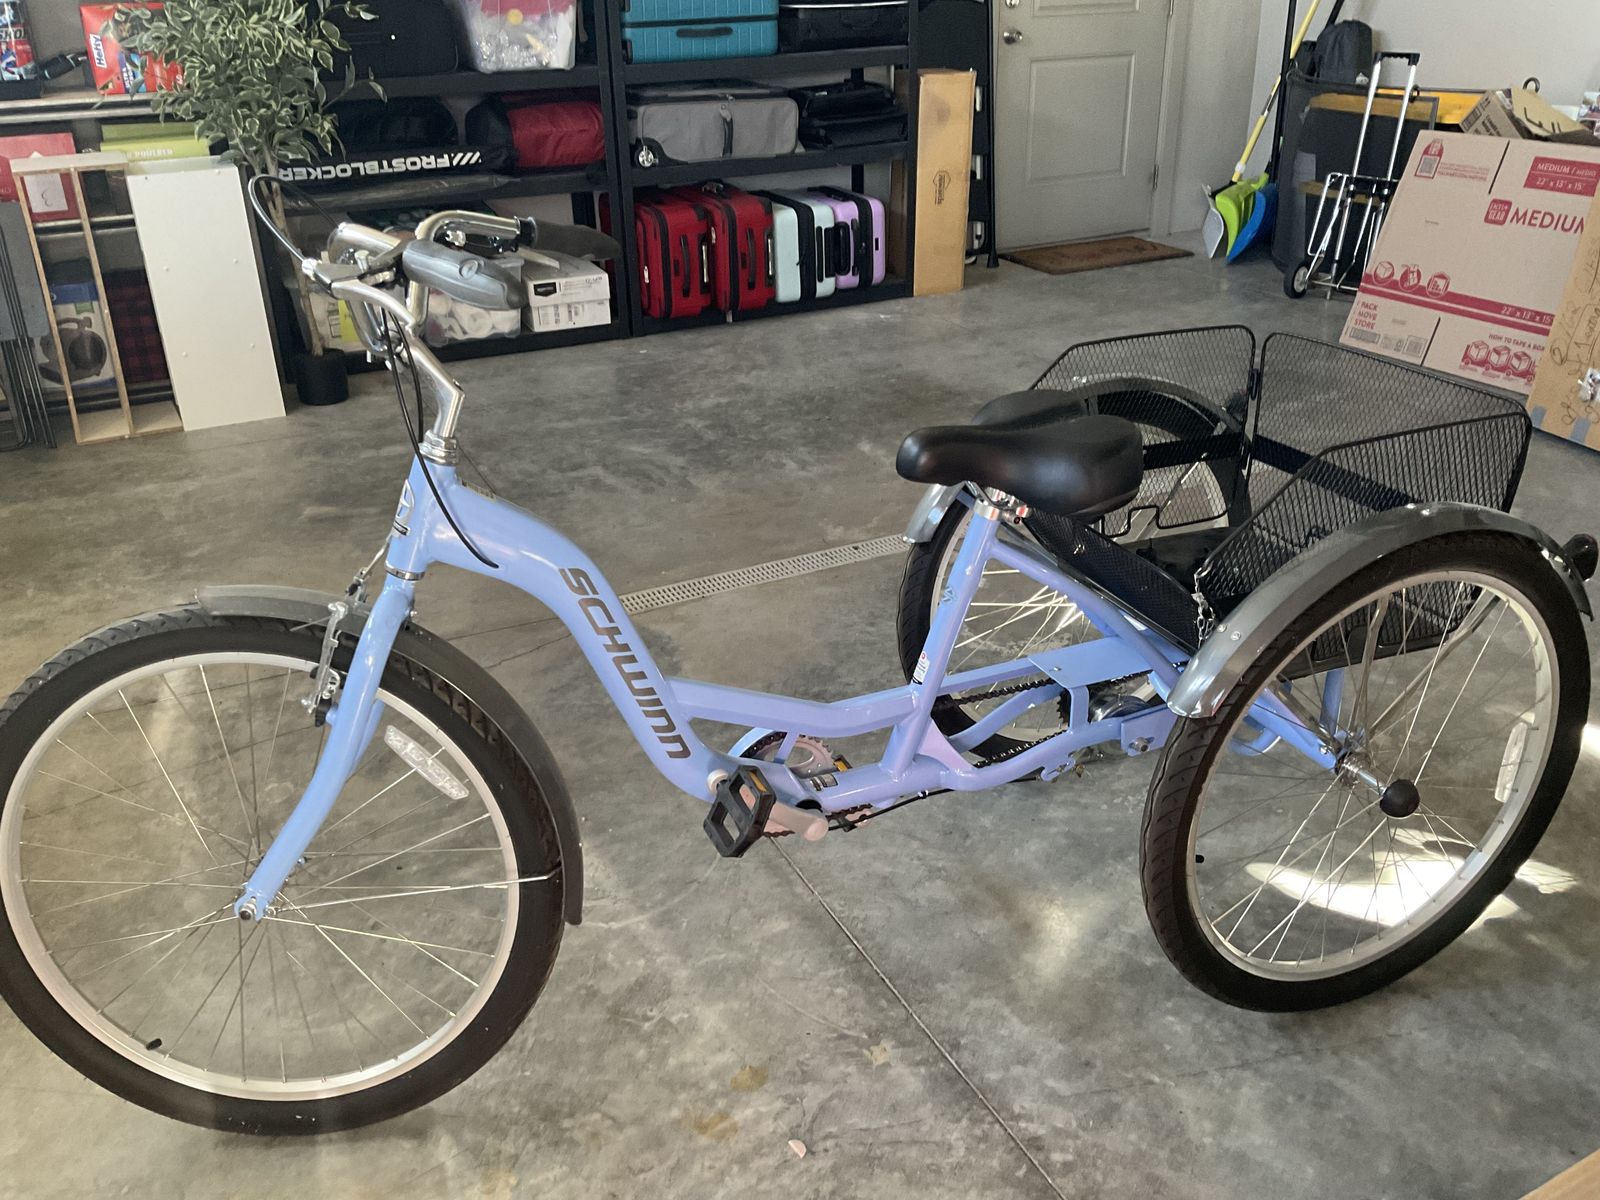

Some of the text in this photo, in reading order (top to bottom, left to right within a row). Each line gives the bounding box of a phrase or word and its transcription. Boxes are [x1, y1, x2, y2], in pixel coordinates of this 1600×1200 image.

[92, 35, 106, 66] Hefty
[279, 153, 450, 182] FROSTBLOCKER
[1536, 163, 1571, 173] MEDIUM
[1361, 301, 1378, 311] PACK
[1358, 311, 1377, 321] MOVE
[1354, 319, 1376, 330] STORE
[1488, 333, 1503, 341] HOW
[1513, 338, 1526, 347] TAPE
[558, 567, 692, 760] SCHWINN
